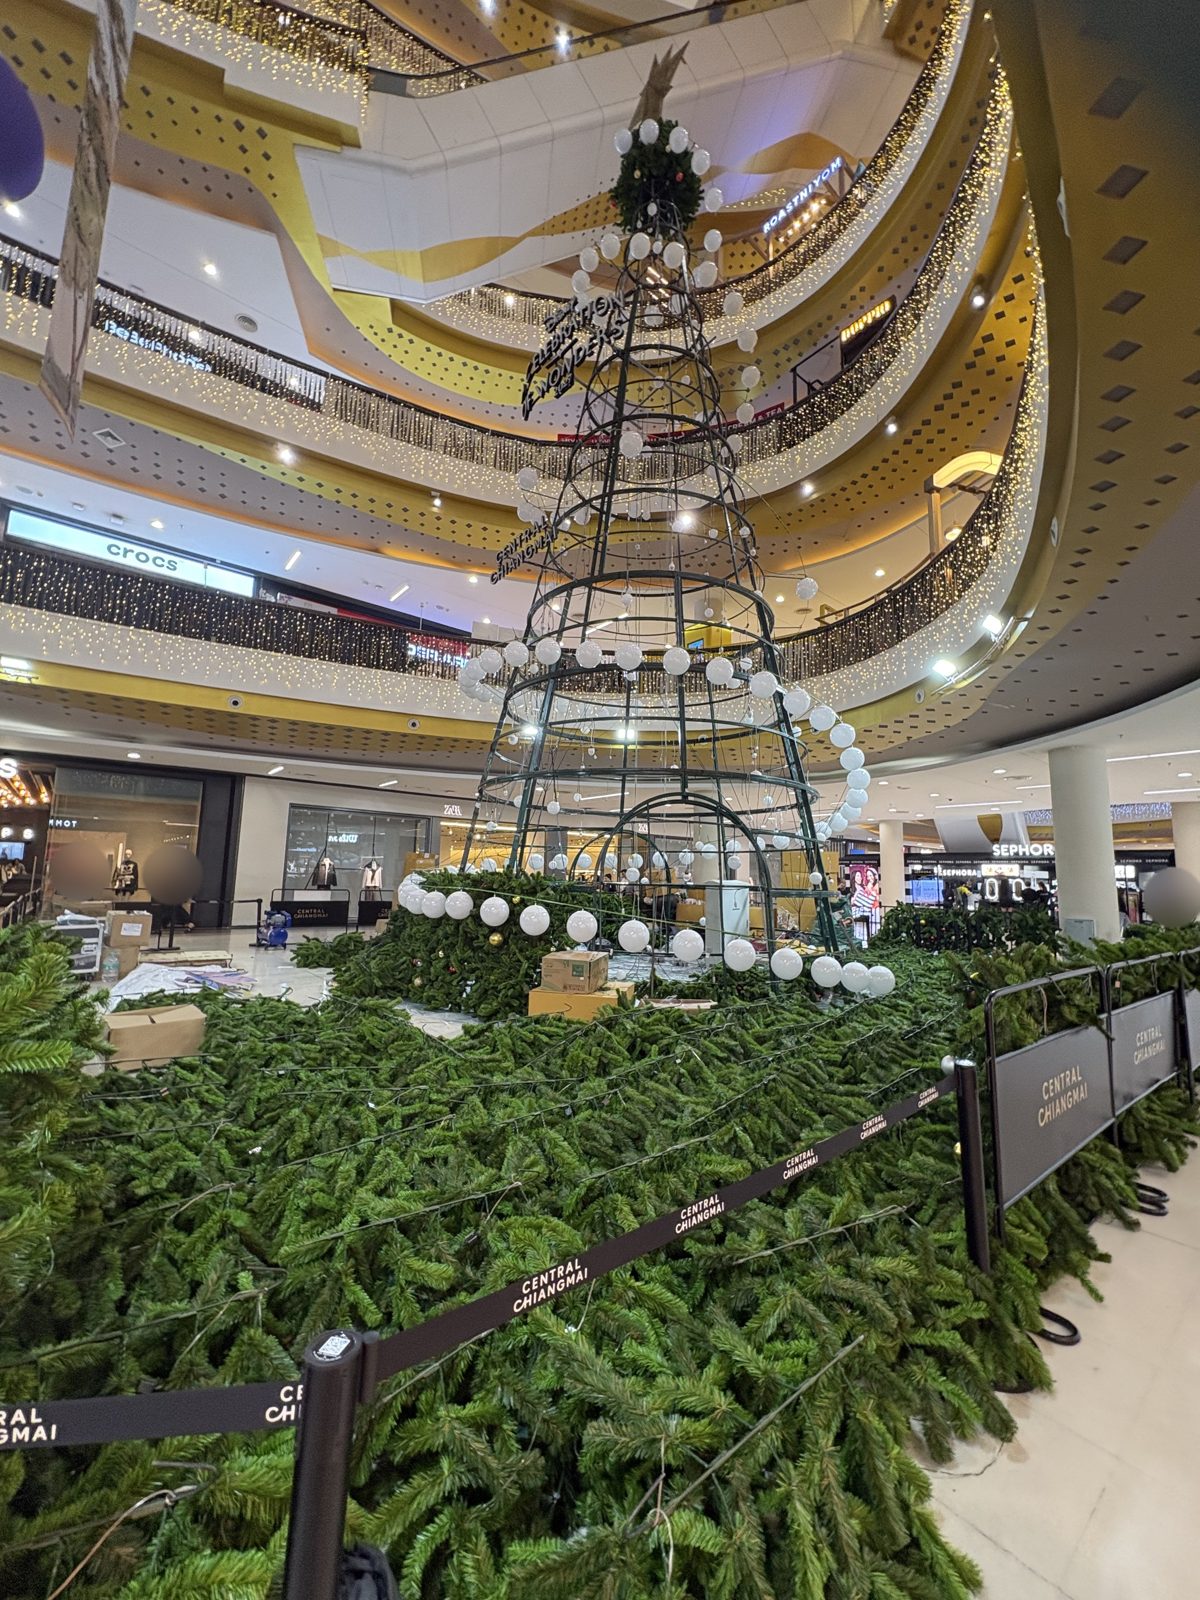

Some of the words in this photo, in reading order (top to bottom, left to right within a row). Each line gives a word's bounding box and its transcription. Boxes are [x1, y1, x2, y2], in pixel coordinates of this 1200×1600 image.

[762, 156, 842, 234] ROASTNIYOM
[535, 322, 625, 399] WONDERS
[496, 515, 549, 564] CENTRAL
[106, 543, 178, 572] crocs
[490, 526, 558, 585] CHIANGMAI
[943, 868, 977, 877] SEPHORA
[1136, 1025, 1162, 1046] CENTRAL
[1133, 1039, 1166, 1065] CHIANGMAI
[919, 1086, 937, 1100] CENTRAL
[1042, 1065, 1083, 1100] CENTRAL
[917, 1091, 939, 1108] CHIANGMAI
[1038, 1082, 1088, 1127] CHIANGMAI
[860, 1120, 887, 1140] CHIANGMAI
[862, 1114, 884, 1130] CENTRAL
[782, 1154, 819, 1180] CHIANGMAI
[786, 1148, 815, 1168] CENTRAL
[675, 1201, 725, 1234] CHIANGMAI
[680, 1194, 720, 1220] CENTRAL
[513, 1267, 588, 1313] CHIANGMAI
[521, 1258, 582, 1295] CENTRAL
